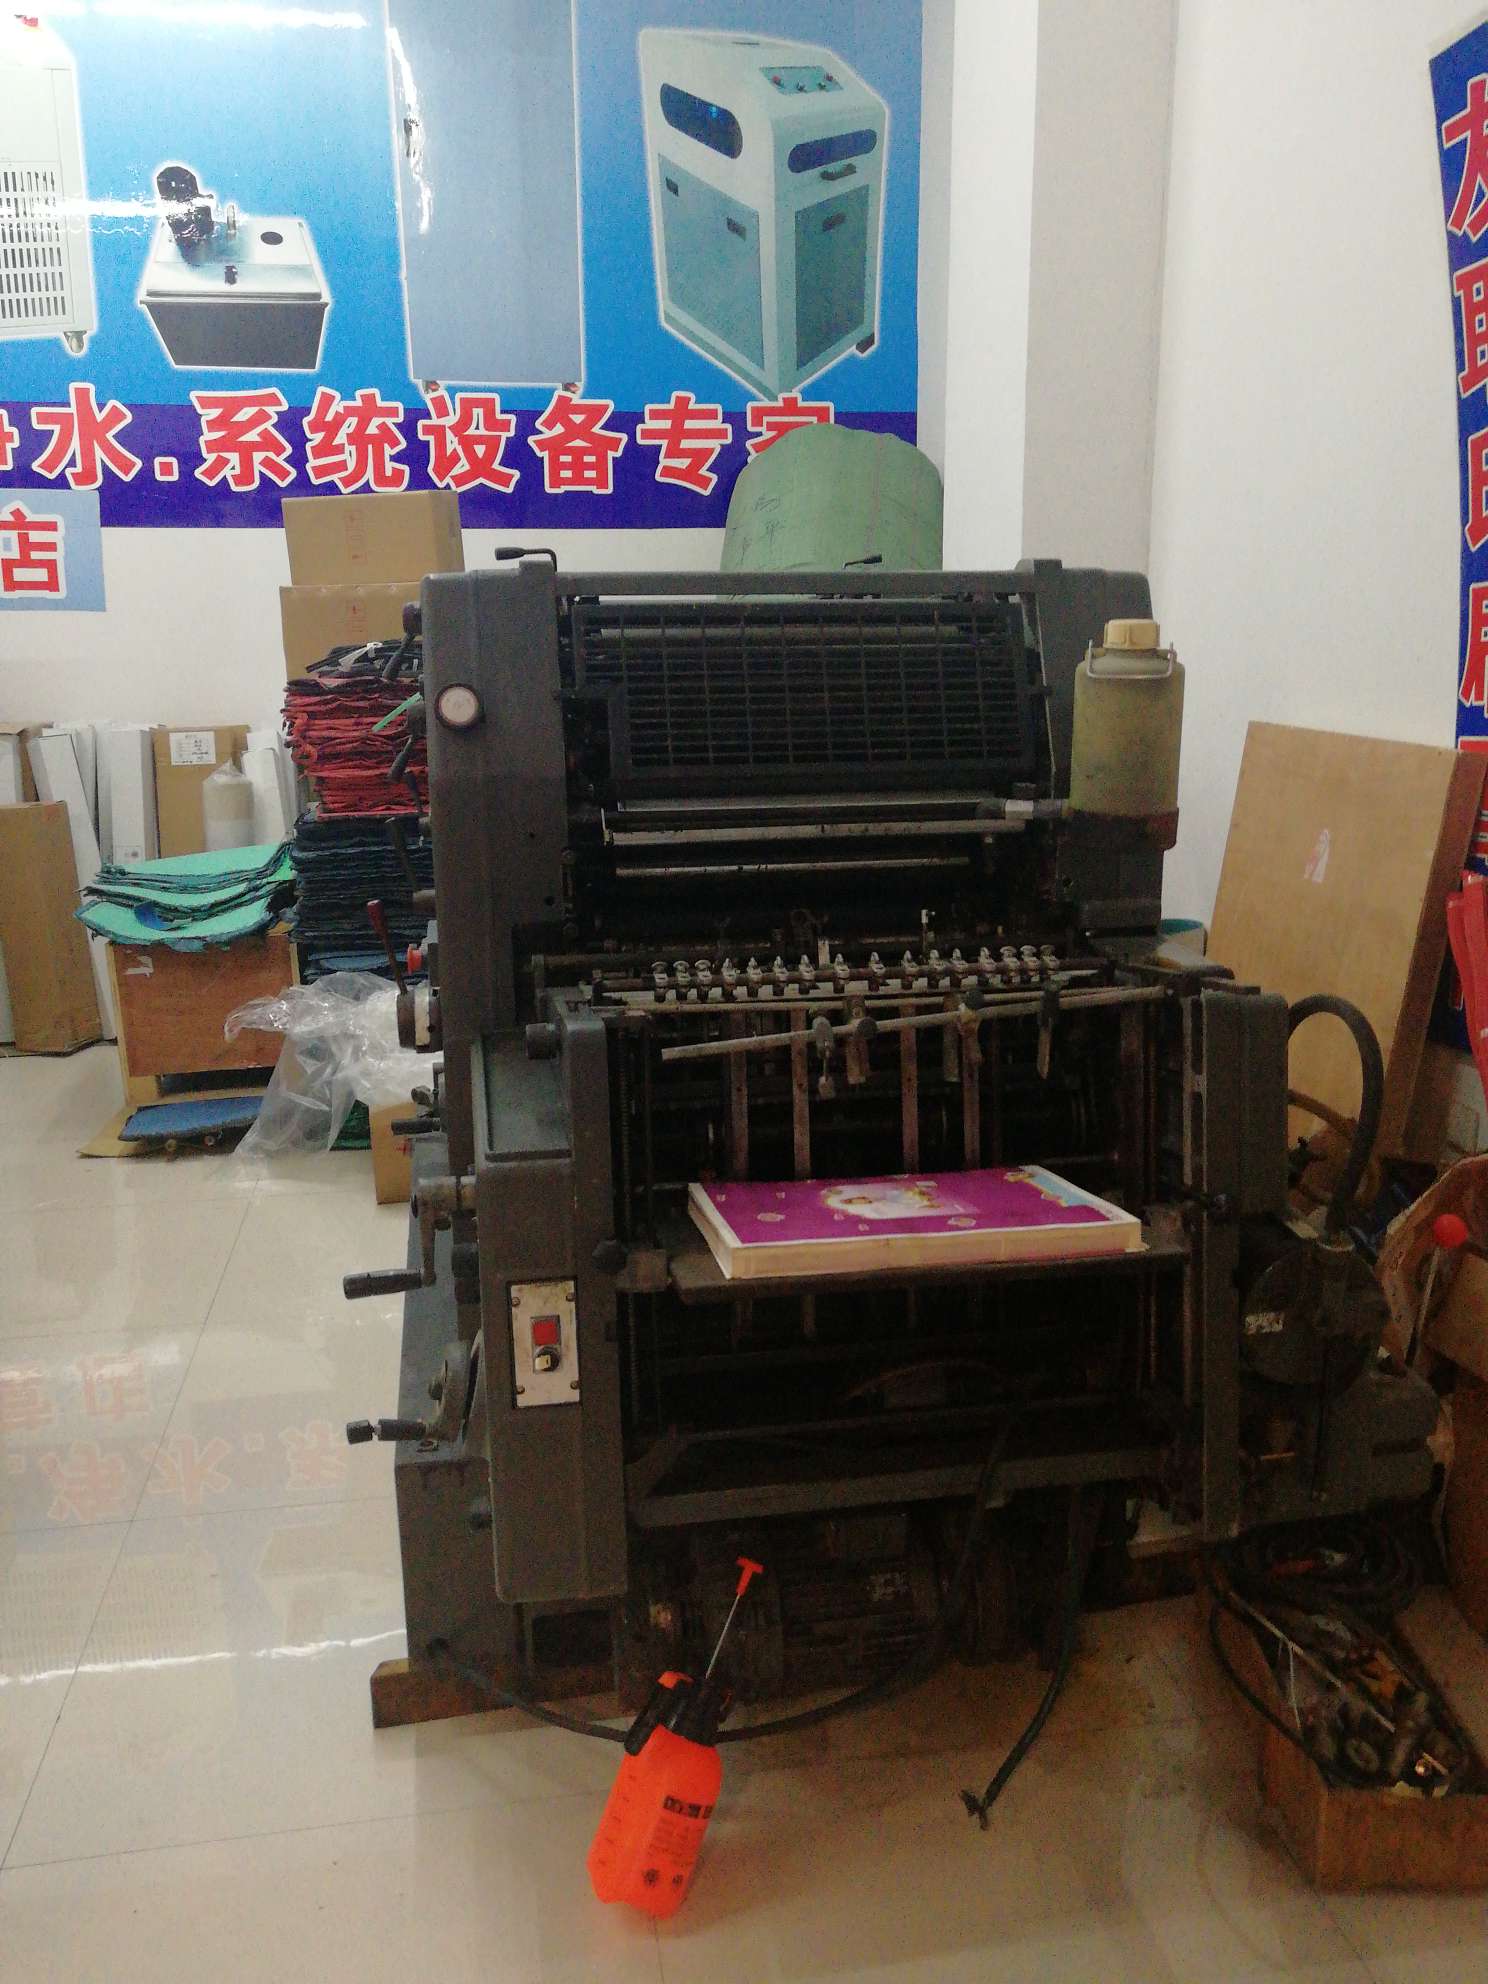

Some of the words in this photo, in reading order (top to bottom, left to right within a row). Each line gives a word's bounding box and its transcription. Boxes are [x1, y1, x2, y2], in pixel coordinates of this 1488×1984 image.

[0, 382, 835, 495] 水.系统设备专
